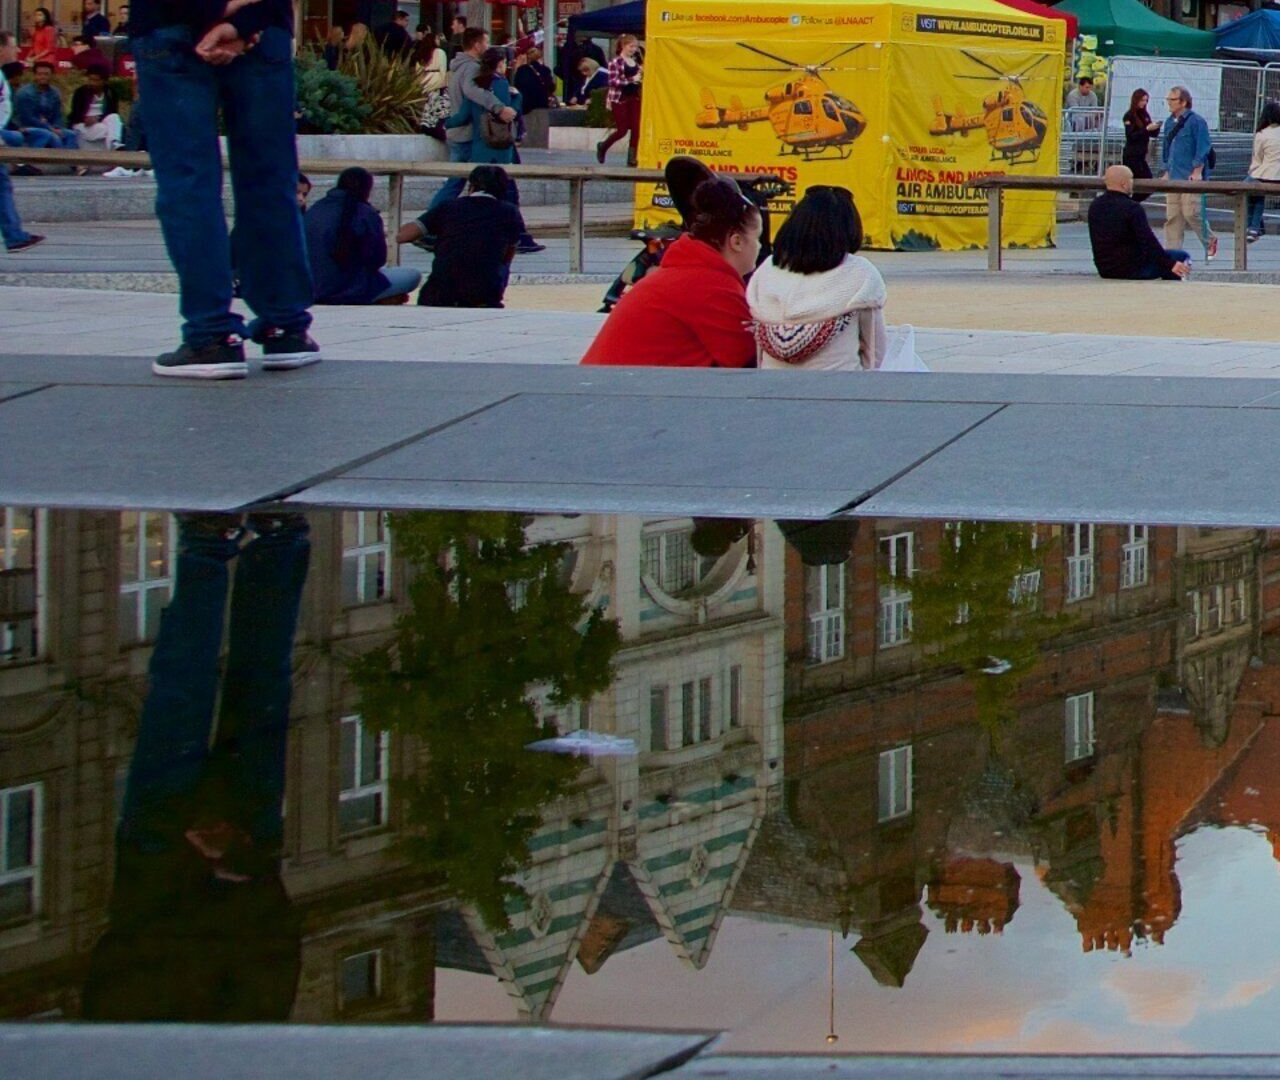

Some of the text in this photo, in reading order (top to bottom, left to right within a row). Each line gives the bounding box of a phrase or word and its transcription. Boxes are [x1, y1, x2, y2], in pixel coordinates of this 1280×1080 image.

[801, 15, 823, 24] Follow
[674, 140, 719, 148] YOUR LOCAL
[896, 167, 934, 182] LINCS
[938, 171, 964, 185] AND
[897, 183, 921, 198] AIR
